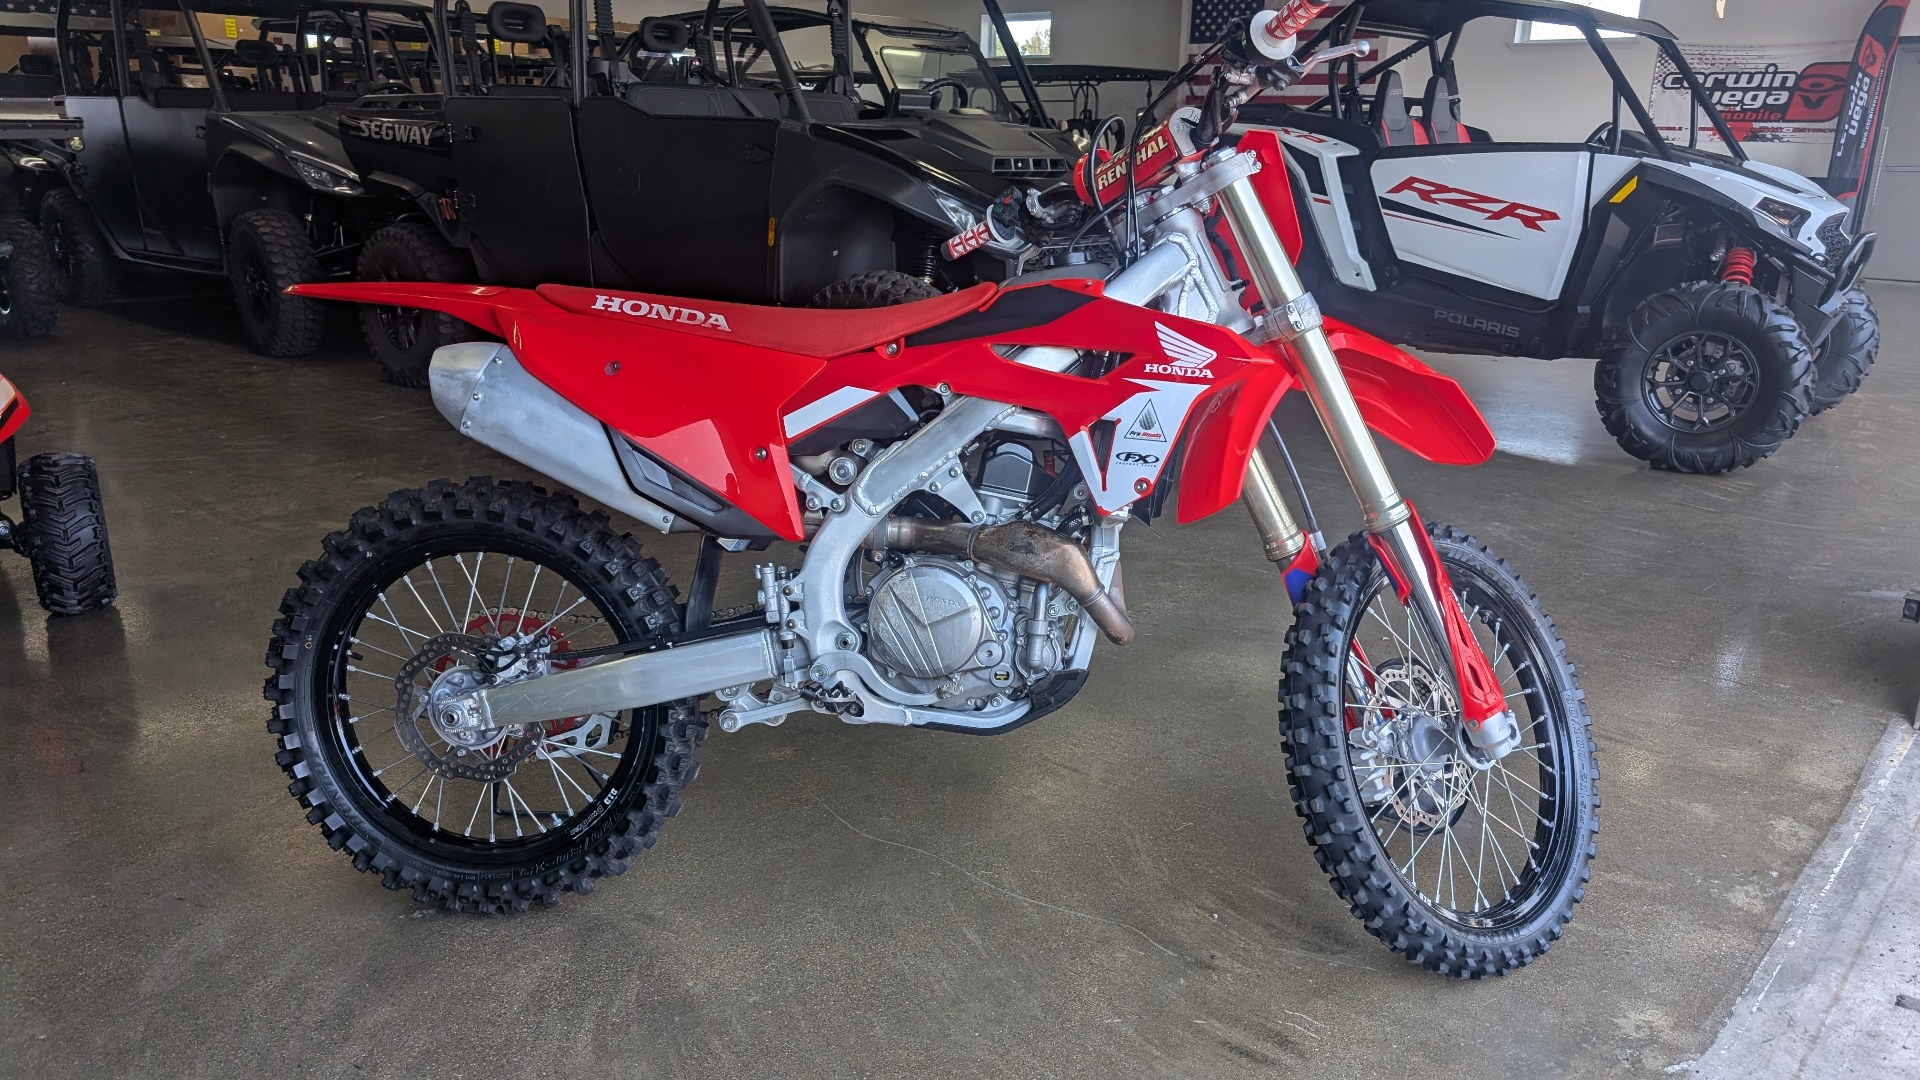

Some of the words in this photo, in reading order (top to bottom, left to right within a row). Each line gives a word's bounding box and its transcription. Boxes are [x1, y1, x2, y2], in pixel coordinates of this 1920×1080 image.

[360, 120, 433, 146] SEGWAY
[1281, 127, 1328, 144] XP
[1097, 135, 1169, 190] RENHAL
[1385, 176, 1561, 233] RZR
[591, 294, 732, 332] HONDA
[1434, 308, 1520, 338] POLARIS
[1144, 363, 1214, 379] HONDA
